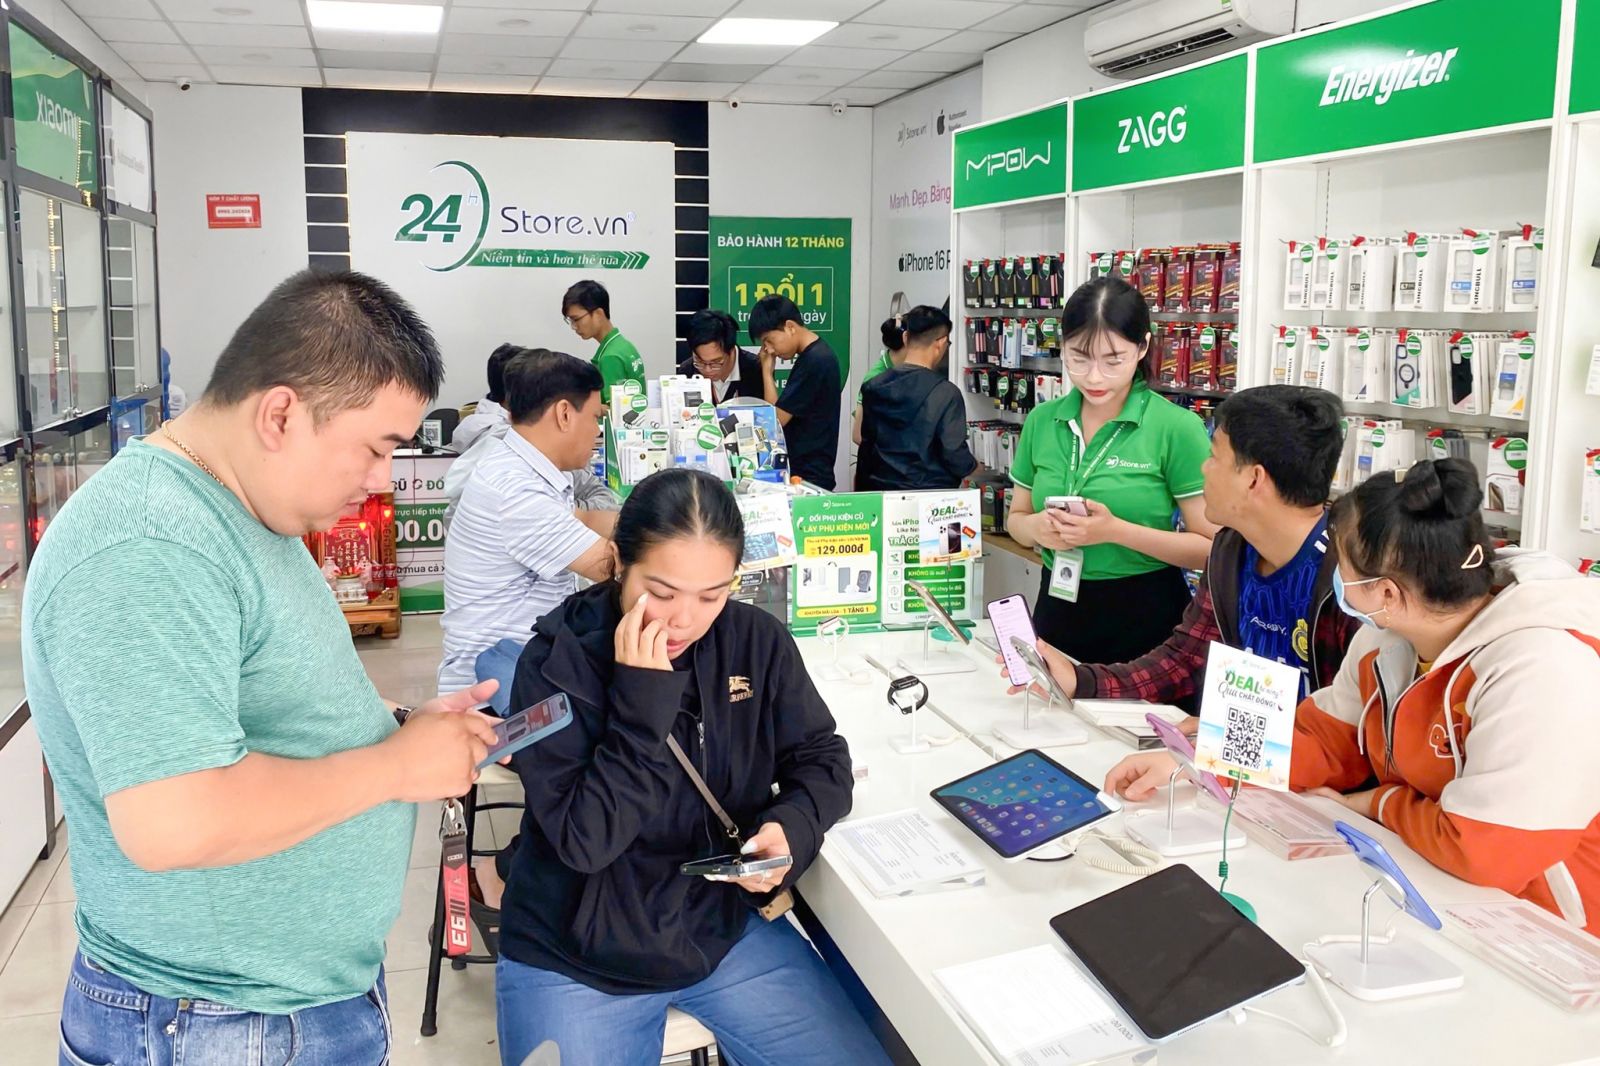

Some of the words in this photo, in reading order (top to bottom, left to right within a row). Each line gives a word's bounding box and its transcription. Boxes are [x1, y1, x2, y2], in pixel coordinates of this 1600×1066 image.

[1117, 104, 1187, 154] ZAGG
[500, 206, 628, 236] Store.vn
[717, 233, 744, 247] BẢO
[746, 234, 782, 247] HÀNH
[785, 237, 799, 248] 12
[801, 235, 845, 248] THÁNG
[537, 252, 549, 264] và
[905, 253, 933, 272] iPhone
[934, 251, 945, 270] 16
[735, 283, 748, 306] 1
[811, 283, 823, 306] 1
[817, 543, 864, 555] 129.000đ
[1225, 670, 1260, 694] DEAL
